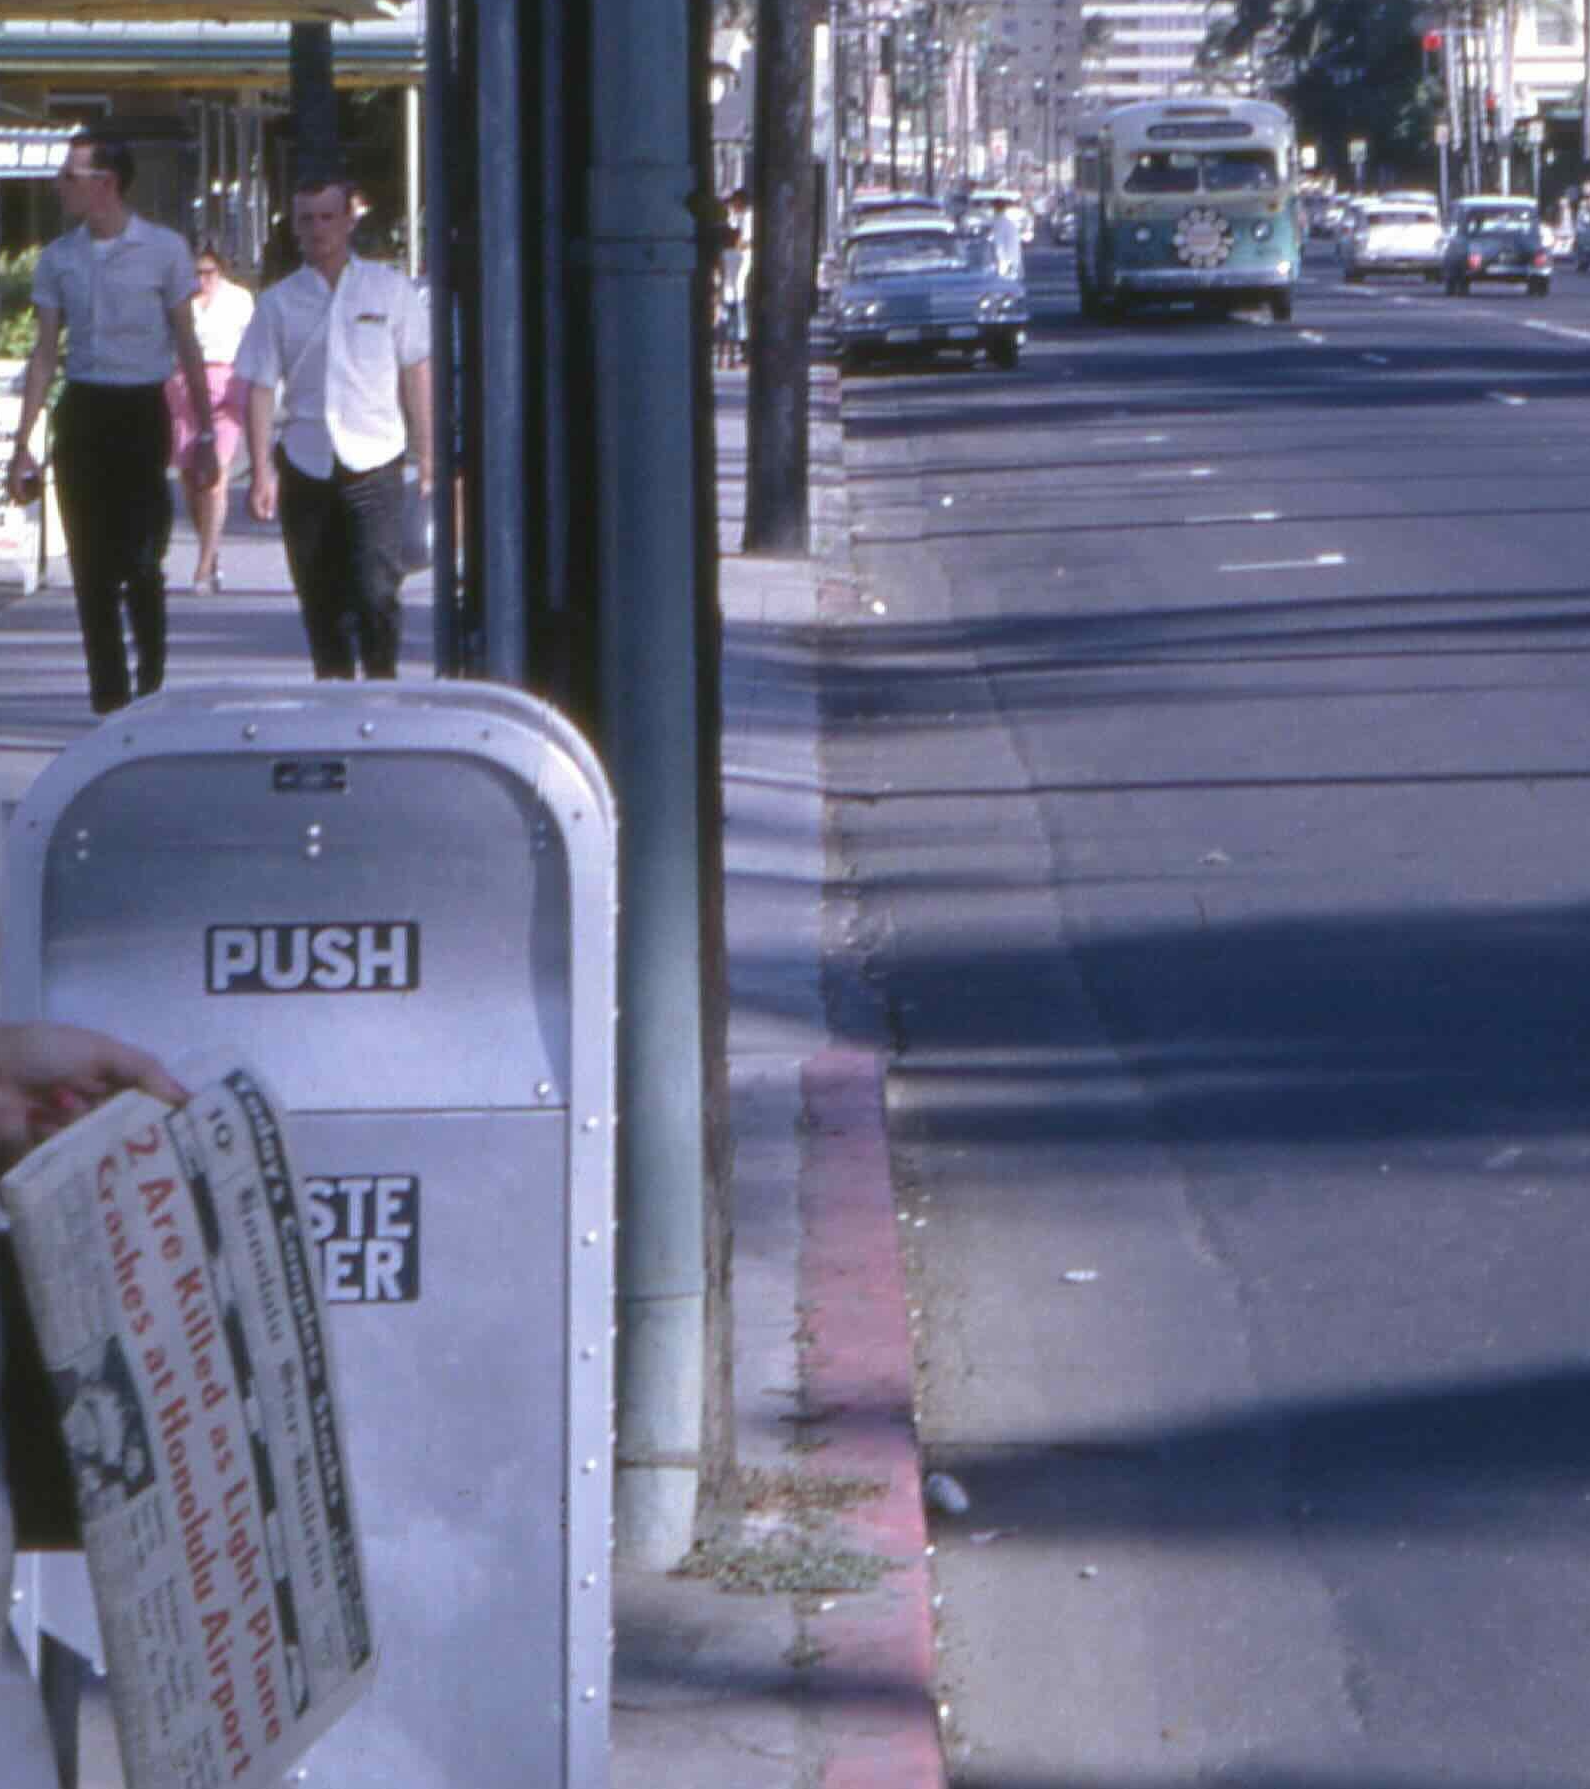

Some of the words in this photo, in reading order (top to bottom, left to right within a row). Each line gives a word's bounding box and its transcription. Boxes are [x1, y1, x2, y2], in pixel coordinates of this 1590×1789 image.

[212, 925, 409, 990] PUSH
[124, 1122, 161, 1157] 2
[96, 1154, 155, 1337] Crashes
[137, 1177, 184, 1260] Are
[322, 1240, 408, 1302] ER
[143, 1347, 176, 1397] at
[173, 1264, 230, 1411] Killed
[159, 1396, 219, 1604] Honolulu
[209, 1425, 235, 1475] as
[222, 1476, 261, 1604] Light
[201, 1608, 252, 1781] Airport
[246, 1603, 282, 1744] Plane
